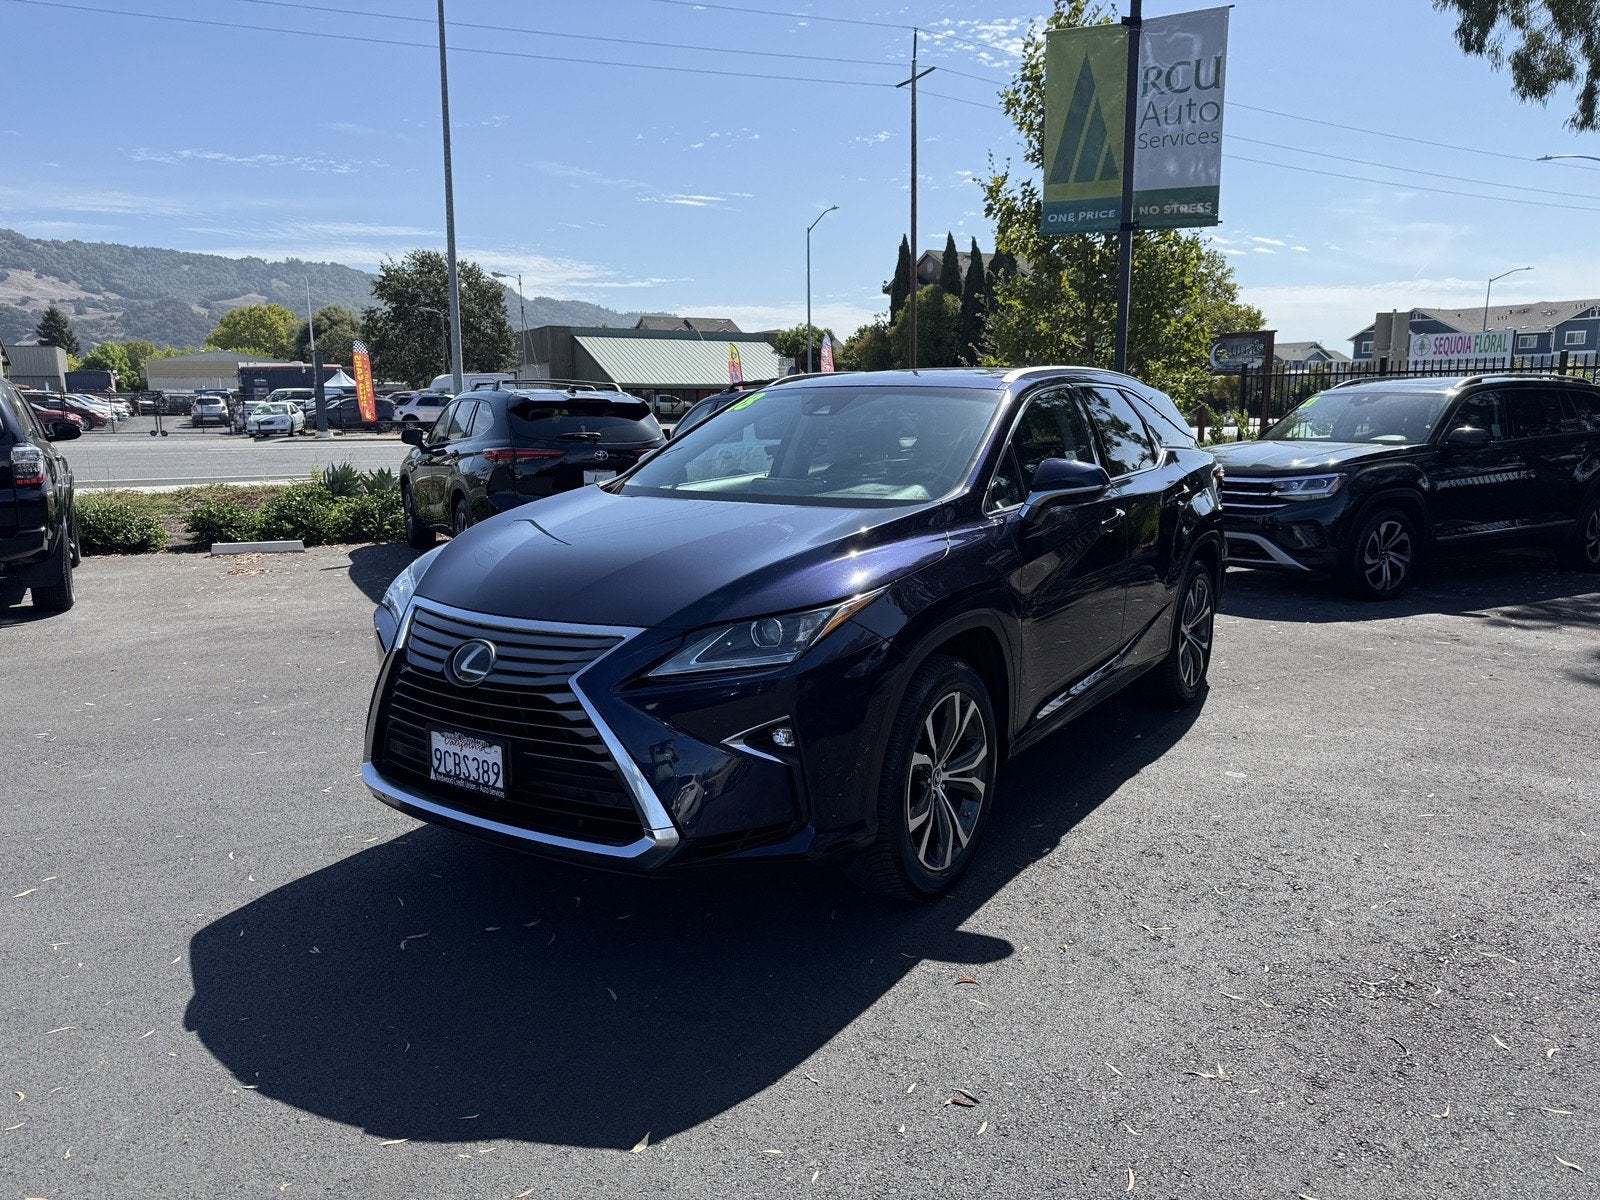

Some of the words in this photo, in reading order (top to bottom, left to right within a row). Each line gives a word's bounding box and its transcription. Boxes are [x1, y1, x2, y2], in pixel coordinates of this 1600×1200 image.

[1141, 56, 1222, 97] RCU
[1139, 98, 1220, 129] Auto
[1138, 129, 1219, 149] Services
[1047, 212, 1075, 223] ONE
[1078, 209, 1116, 221] PRICE
[1139, 205, 1160, 216] NO
[1163, 202, 1212, 214] STRESS
[1433, 335, 1472, 356] SEQUOIA
[1474, 334, 1508, 353] FLORAL
[434, 747, 501, 787] 9CBS389
